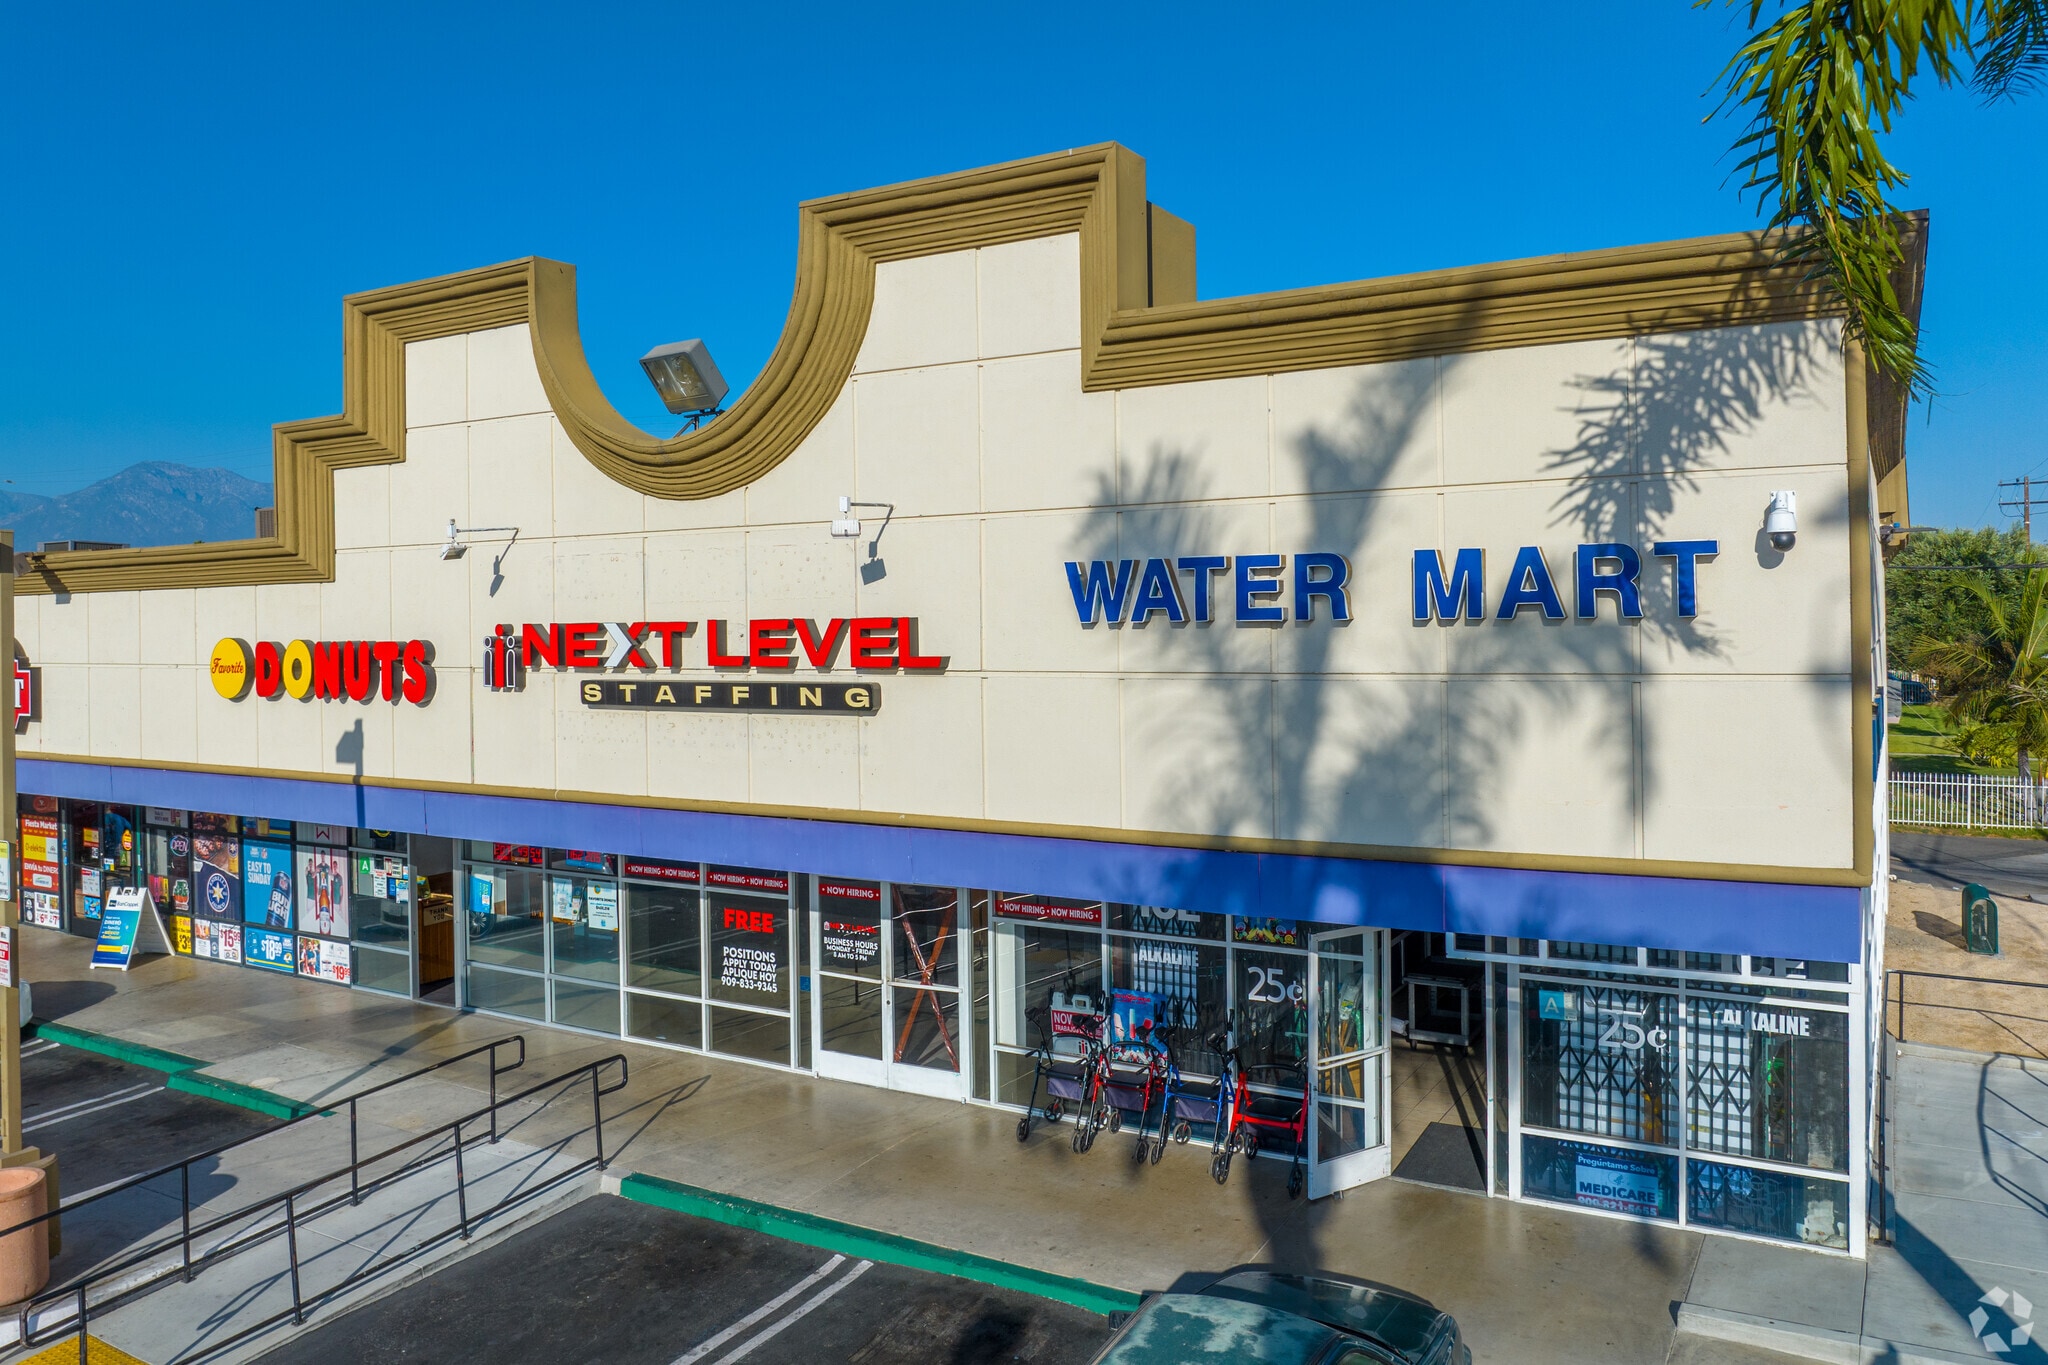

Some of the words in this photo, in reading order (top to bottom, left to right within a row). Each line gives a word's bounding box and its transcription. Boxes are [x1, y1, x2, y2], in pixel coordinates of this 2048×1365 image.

[1063, 553, 1352, 625] WATER
[1412, 540, 1721, 621] MART
[522, 620, 690, 668] NEXT
[707, 616, 944, 669] LEVEL
[211, 657, 244, 674] Favorite
[255, 639, 427, 704] DONUTS
[583, 683, 872, 709] STAFFING
[25, 819, 40, 828] Fiesta
[40, 821, 58, 830] Market
[172, 840, 188, 852] OPEN
[248, 860, 262, 873] EASY
[263, 862, 272, 874] TO
[361, 860, 370, 871] A
[630, 865, 643, 874] NOW
[643, 867, 661, 875] HIRING
[664, 869, 677, 877] NOW
[678, 870, 696, 879] HIRING
[248, 872, 271, 885] SUNDAY
[713, 874, 726, 882] NOW
[726, 875, 746, 884] HIRING
[750, 878, 763, 887] NOW
[764, 879, 784, 888] HIRING
[826, 886, 845, 894] NOW
[847, 888, 874, 898] HIRING
[430, 906, 449, 915] THANK
[1004, 903, 1020, 912] NOW
[1021, 904, 1045, 915] HIRING
[1051, 907, 1068, 917] NOW
[1069, 909, 1094, 920] HIRING
[723, 907, 775, 934] FREE
[829, 921, 850, 930] NEXT
[823, 936, 854, 947] BUSINESS
[854, 940, 879, 950] HOURS
[826, 944, 851, 953] MONDAY
[855, 948, 876, 956] FRIDAY
[723, 946, 776, 963] POSITIONS
[1138, 945, 1199, 968] ALKALINE
[722, 957, 748, 969] APPLY
[749, 960, 777, 973] TODAY
[722, 966, 758, 980] APLIQUE
[759, 972, 777, 983] HOY
[721, 976, 778, 993] 909-833-9345
[1247, 966, 1303, 1006] 25¢
[1544, 997, 1560, 1014] A
[1722, 1008, 1811, 1037] ALKALINE
[1598, 1010, 1668, 1053] 25¢
[1577, 1152, 1629, 1171] Pregúntame
[1629, 1163, 1656, 1175] Sobre
[1579, 1181, 1656, 1203] MEDICARE
